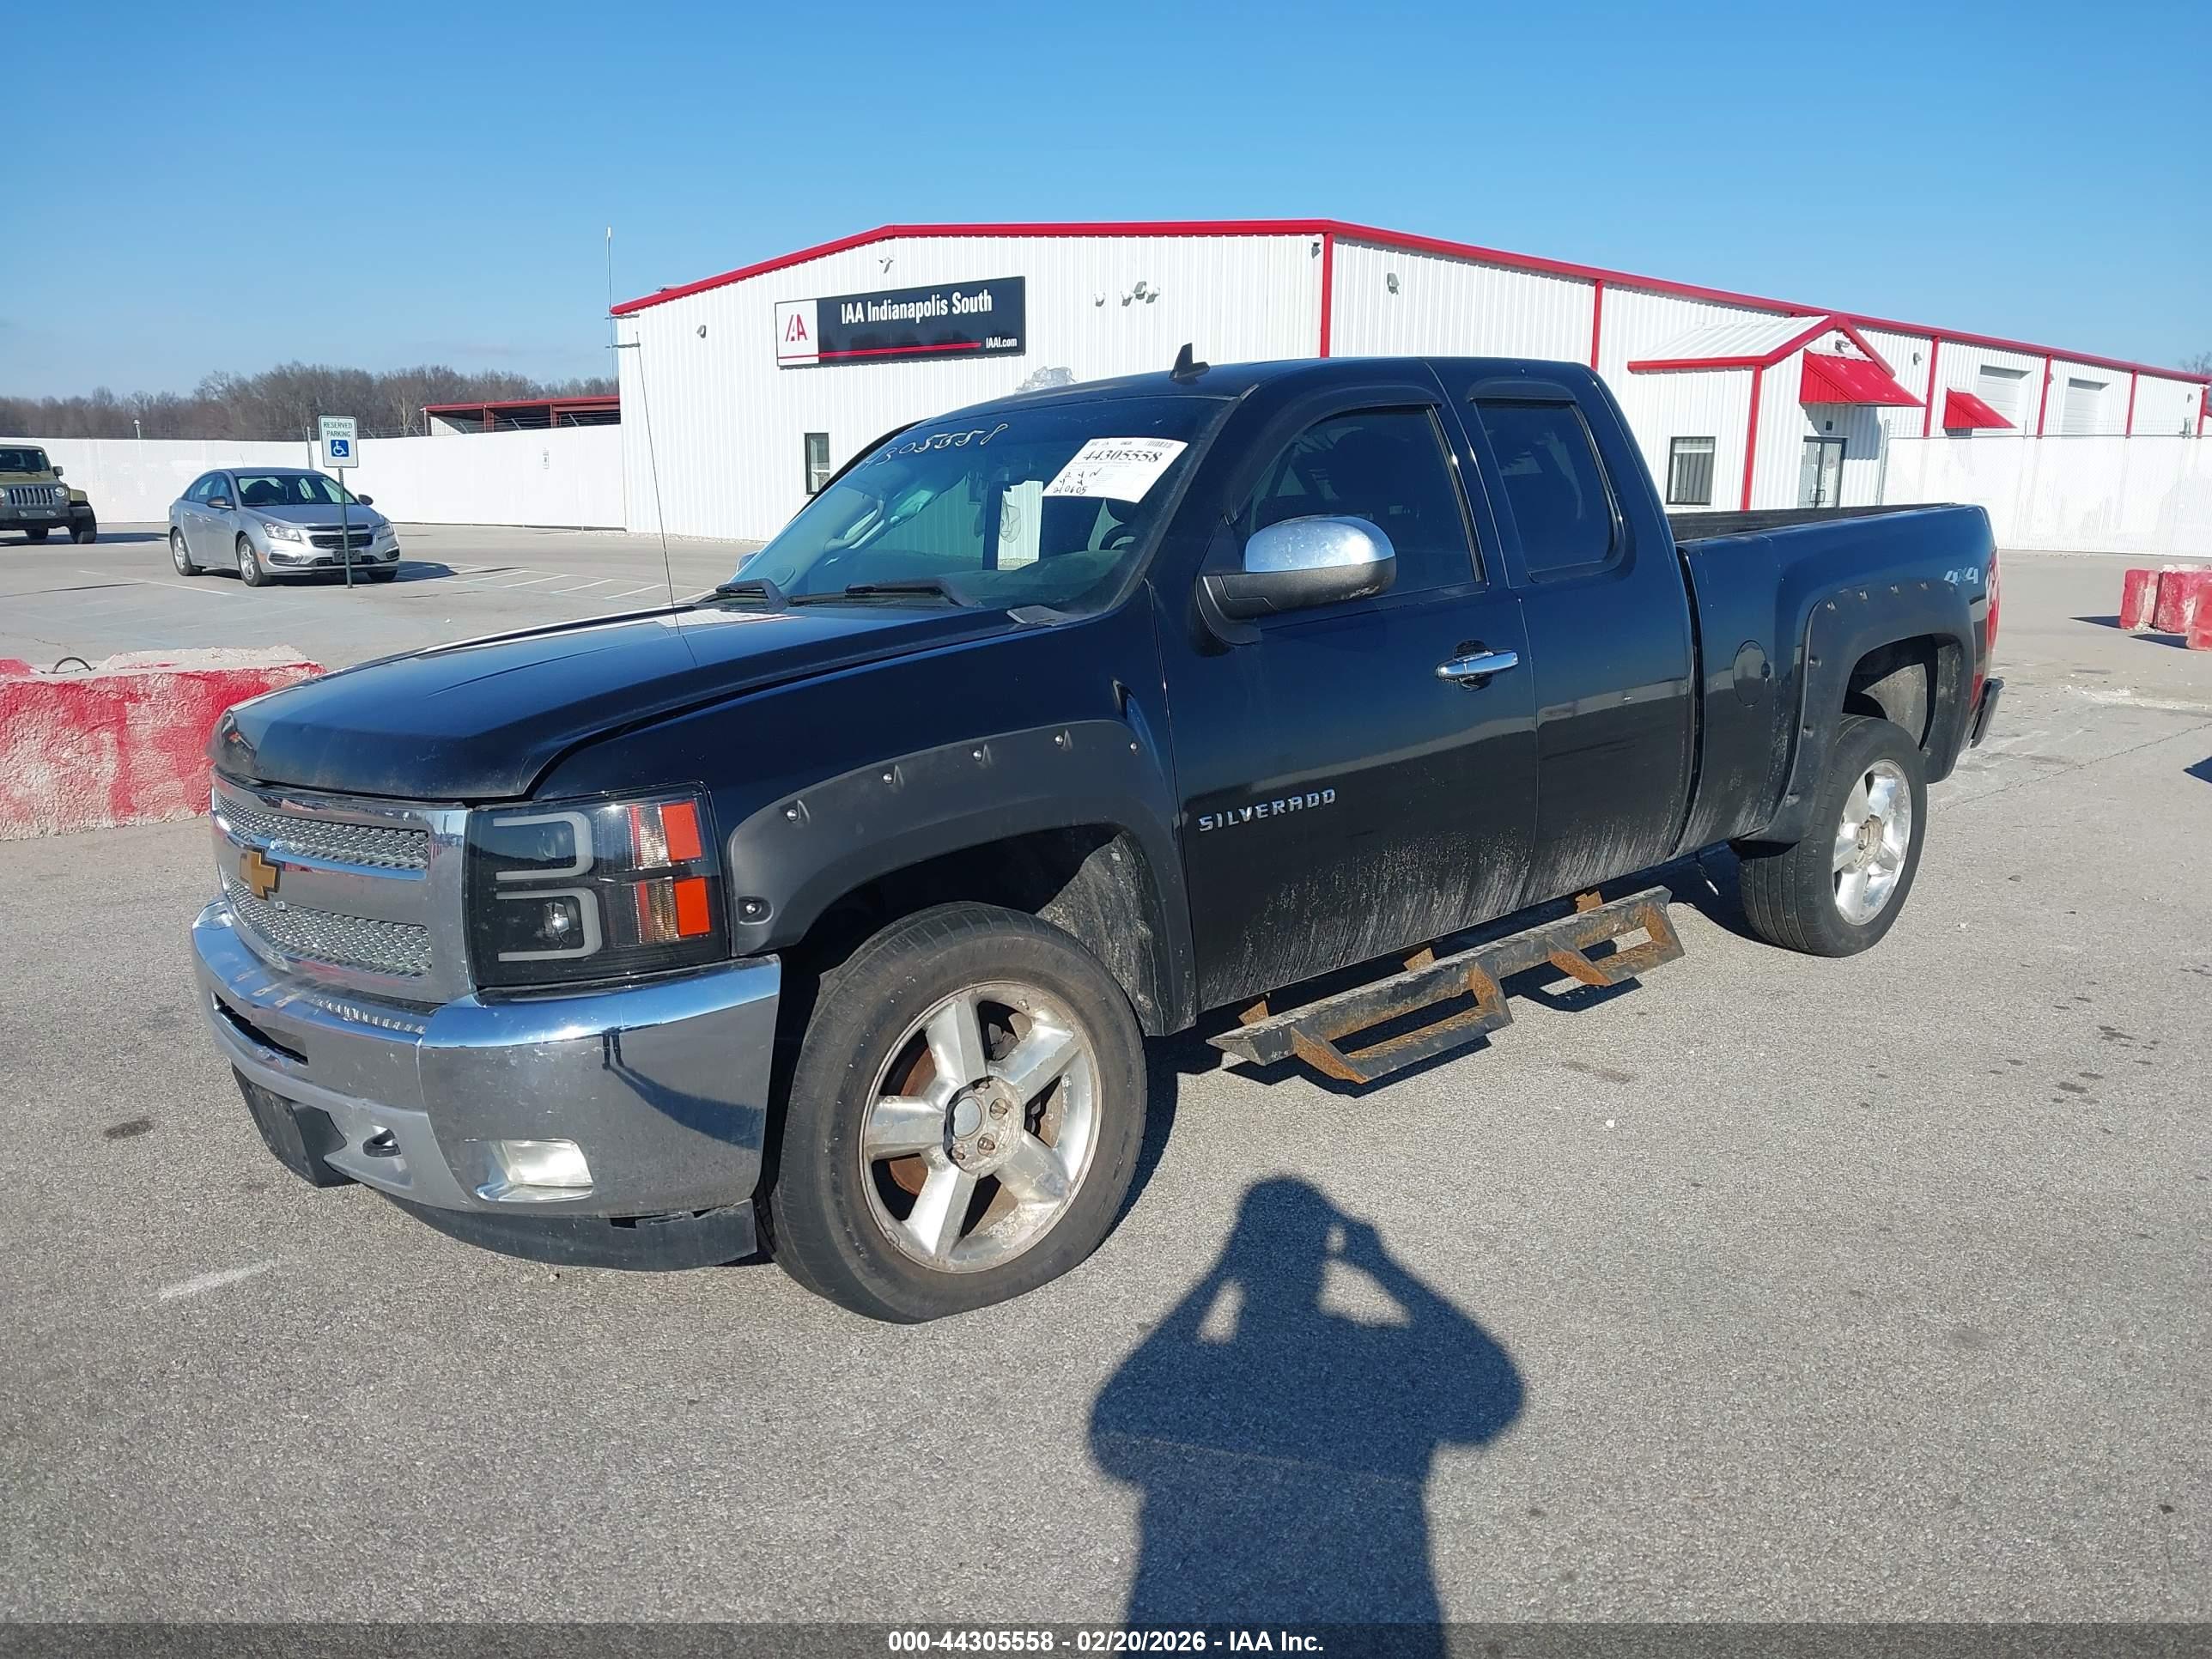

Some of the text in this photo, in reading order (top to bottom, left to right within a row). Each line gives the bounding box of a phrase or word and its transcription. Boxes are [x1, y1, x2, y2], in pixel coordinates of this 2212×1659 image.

[842, 289, 992, 324] IAA Indianapolis South
[323, 421, 353, 429] RESERVED
[1083, 450, 1163, 463] 44305558
[1199, 788, 1336, 832] SILVERADO
